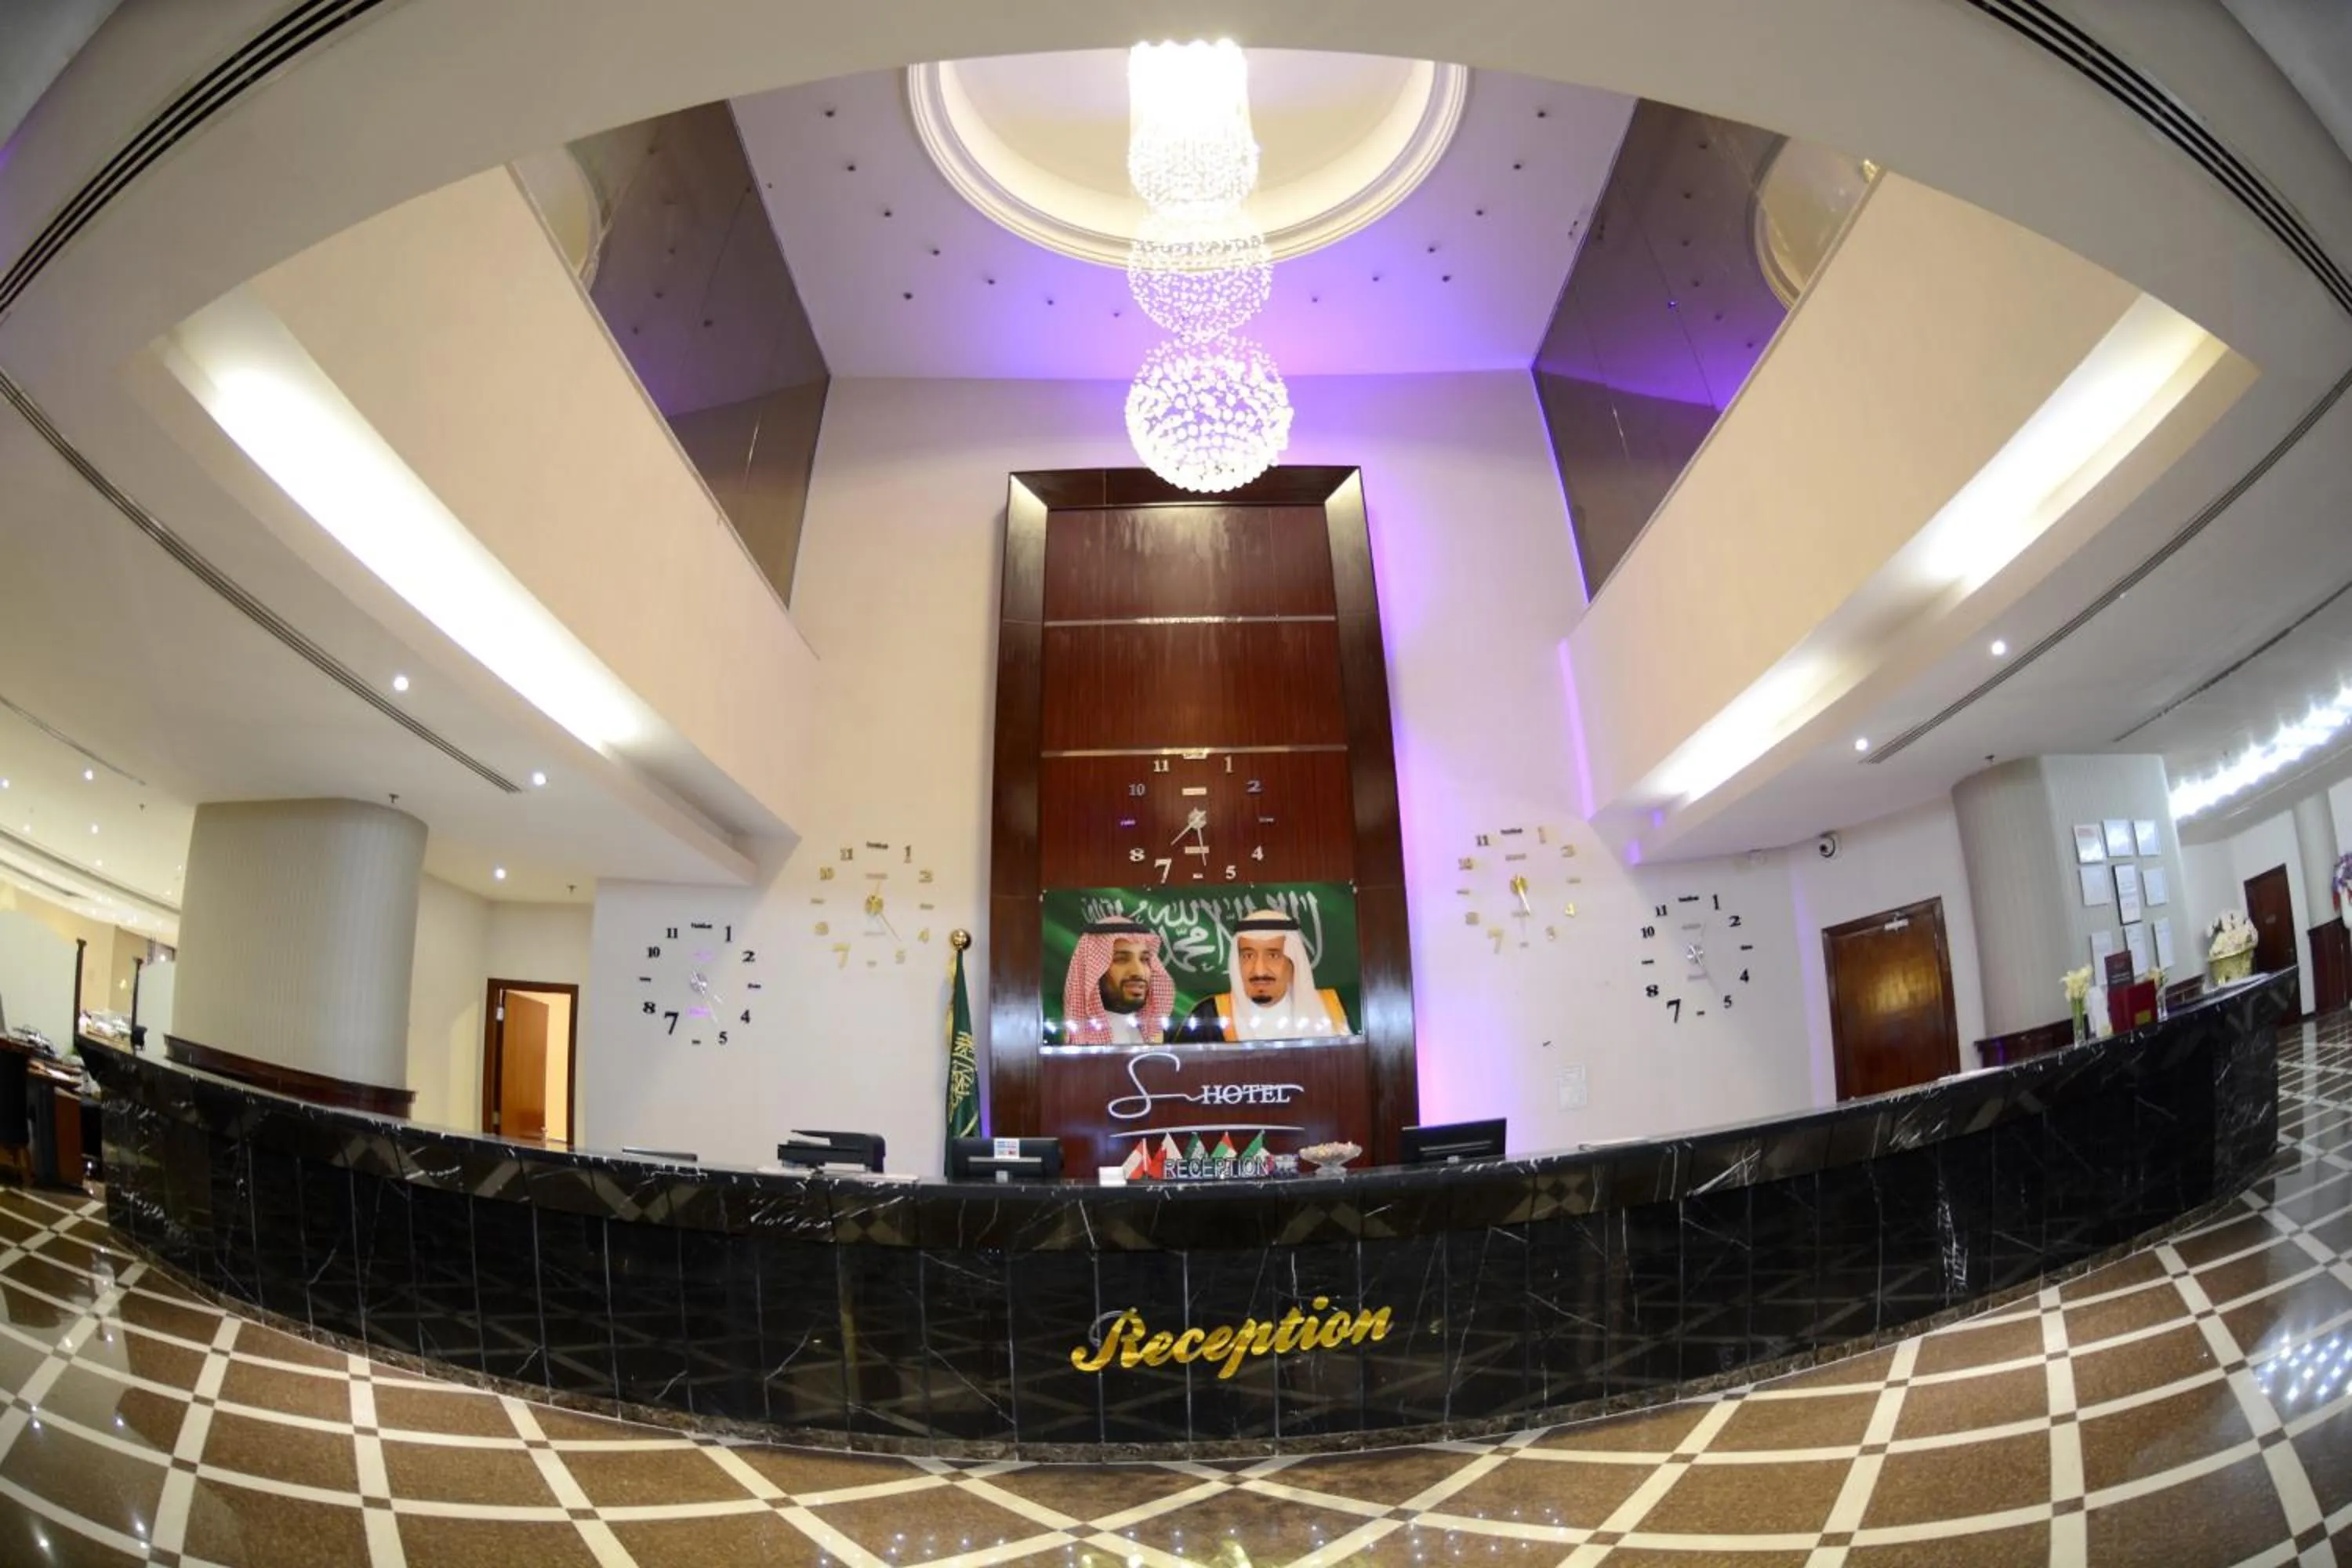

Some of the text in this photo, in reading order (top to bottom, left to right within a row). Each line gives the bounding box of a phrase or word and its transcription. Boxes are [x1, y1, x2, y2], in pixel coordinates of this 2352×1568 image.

[1153, 760, 1169, 772] 11
[1225, 757, 1234, 774] 1
[1128, 784, 1145, 796] 10
[1247, 781, 1262, 793] 2
[1476, 835, 1489, 847] 11
[904, 845, 912, 863] 1
[1129, 848, 1145, 861] 8
[1251, 846, 1263, 861] 4
[1155, 858, 1172, 884] 7
[1225, 866, 1236, 879] 5
[1713, 895, 1720, 910] 1
[1656, 905, 1667, 917] 11
[1730, 916, 1740, 927] 2
[666, 927, 677, 938] 11
[725, 925, 731, 942] 1
[1641, 926, 1654, 938] 10
[648, 946, 660, 958] 10
[742, 950, 755, 962] 2
[833, 943, 851, 970] 7
[1740, 969, 1749, 983] 4
[1646, 985, 1659, 997] 8
[643, 1002, 655, 1014] 8
[1724, 995, 1732, 1008] 5
[741, 1010, 750, 1023] 4
[1667, 999, 1681, 1023] 7
[665, 1011, 679, 1035] 7
[719, 1031, 728, 1044] 5
[1201, 1083, 1291, 1105] HOTEL
[1163, 1158, 1269, 1179] RECEPTION
[1070, 1295, 1392, 1380] Reception
